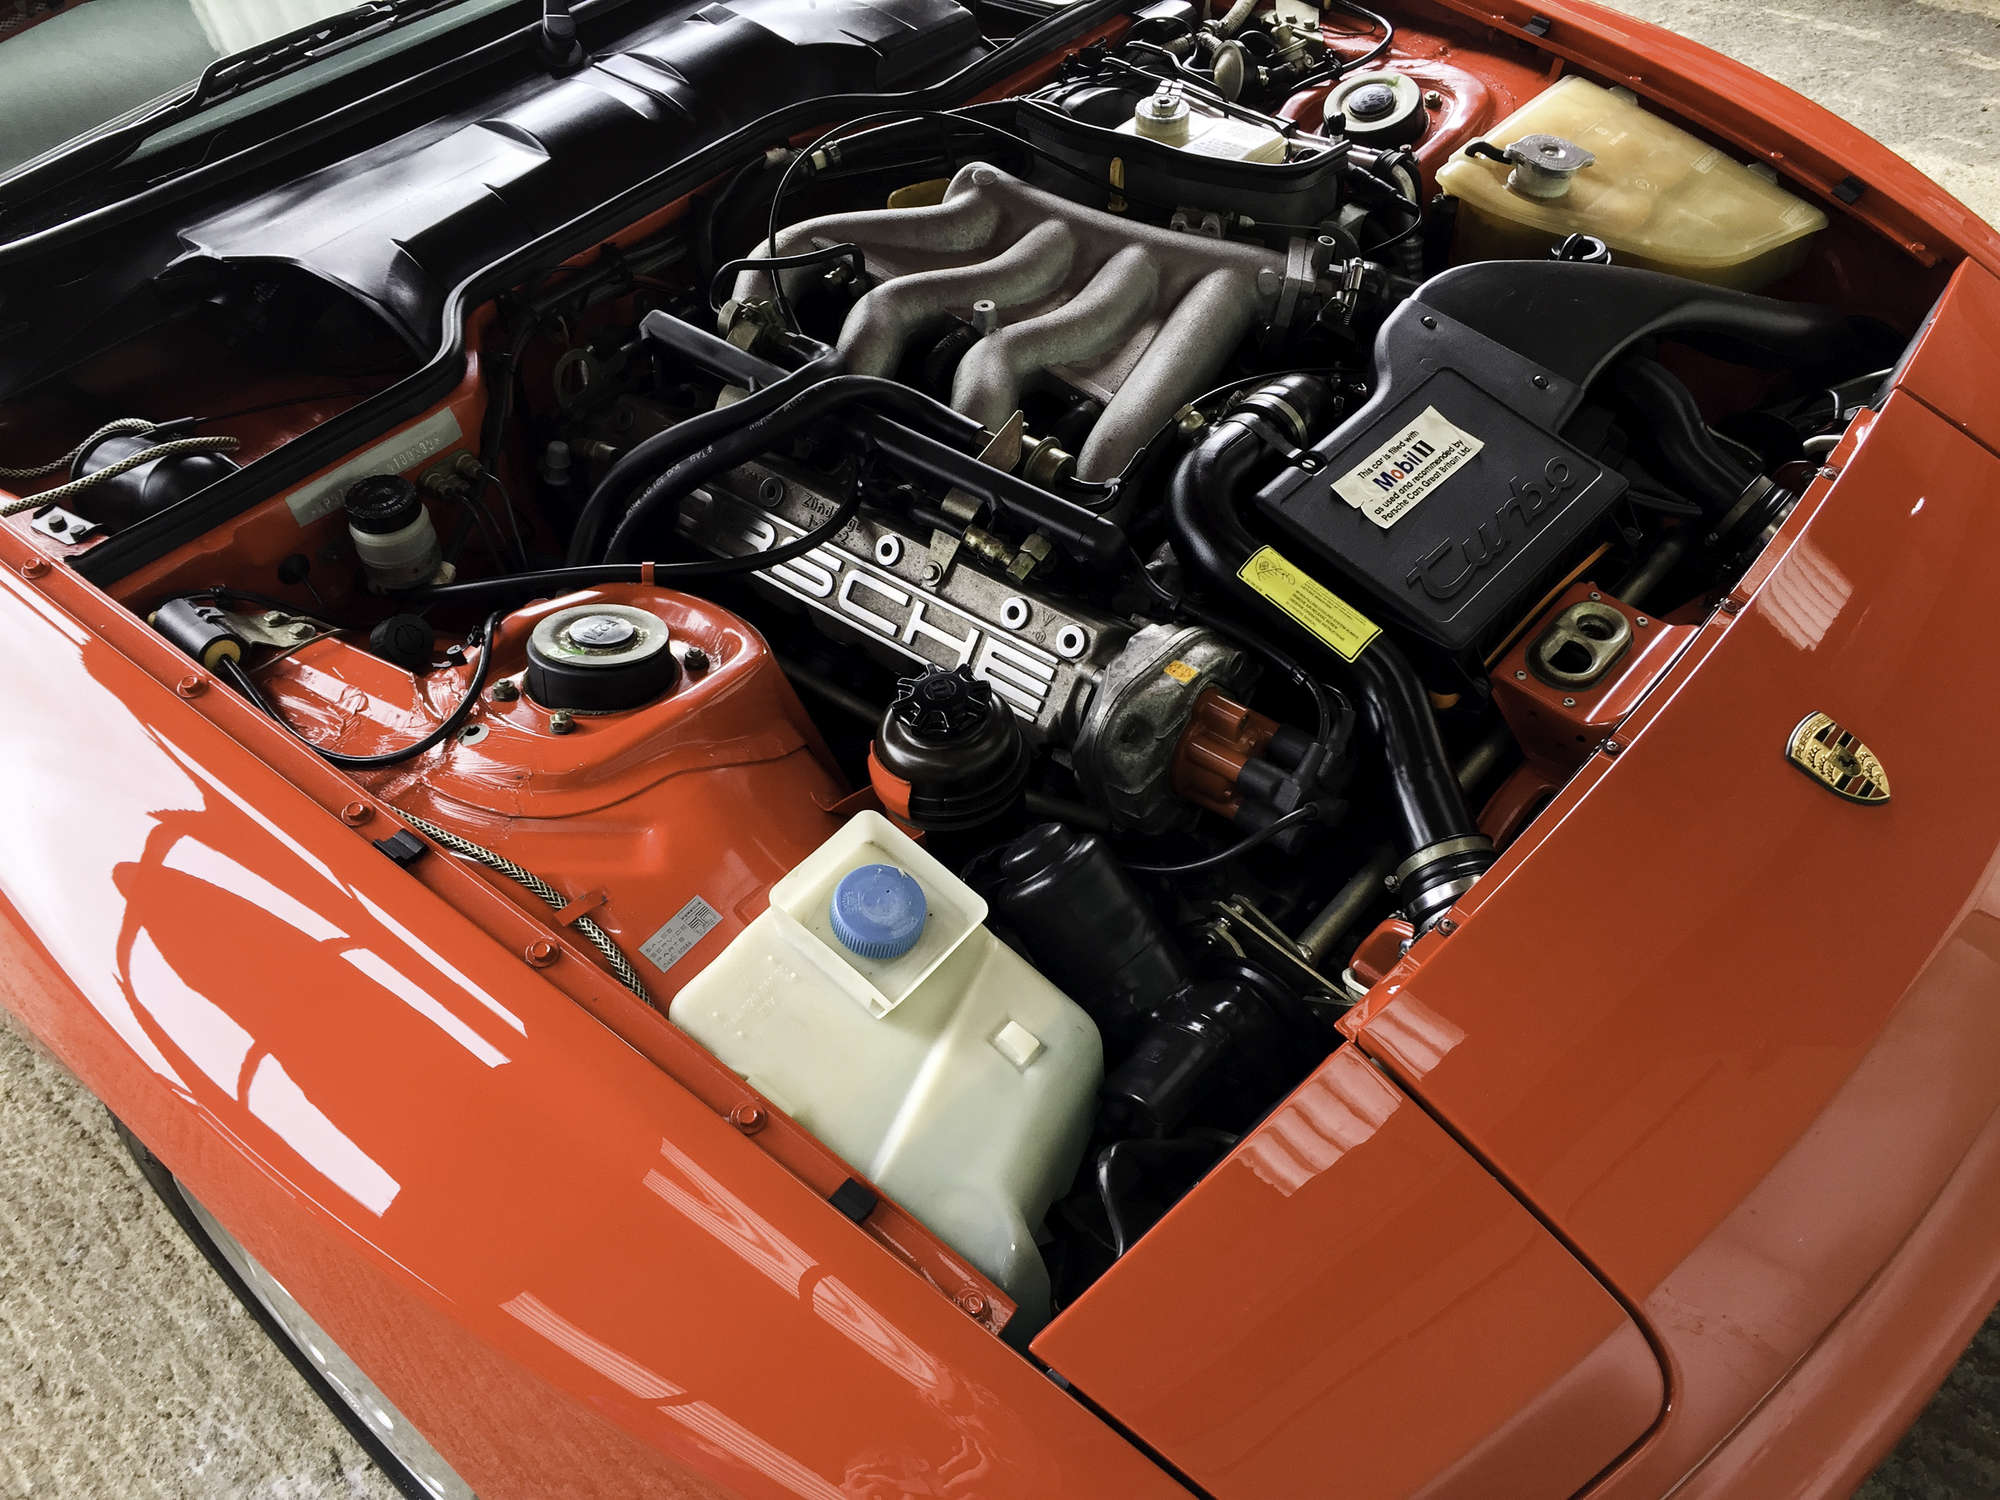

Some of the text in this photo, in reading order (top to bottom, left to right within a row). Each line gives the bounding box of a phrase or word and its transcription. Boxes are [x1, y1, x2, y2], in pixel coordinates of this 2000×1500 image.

[1357, 430, 1419, 479] This car is filled with
[1372, 450, 1423, 491] Mobil
[1374, 439, 1464, 515] as used and recommended by
[1381, 498, 1409, 522] Porsche
[1407, 486, 1425, 500] Cars
[1423, 470, 1442, 488] Great
[1439, 454, 1462, 473] Britain
[740, 520, 1060, 716] SCHE
